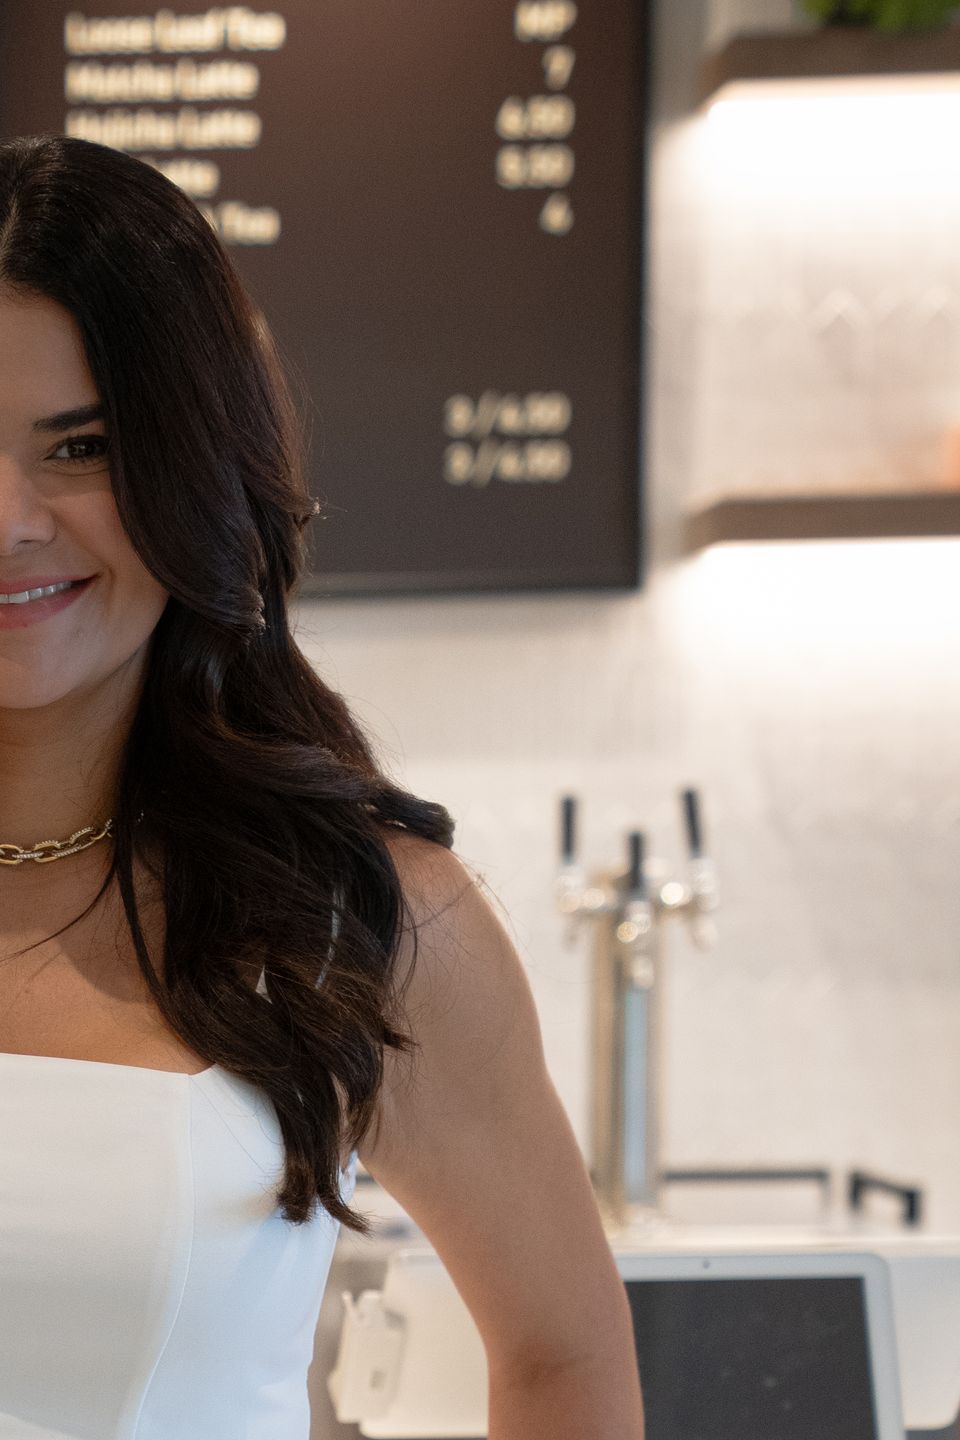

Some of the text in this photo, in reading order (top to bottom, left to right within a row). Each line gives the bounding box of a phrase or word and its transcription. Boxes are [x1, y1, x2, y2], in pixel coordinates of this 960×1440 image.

[224, 8, 285, 49] Tea
[179, 59, 260, 99] Latte
[180, 107, 261, 147] Latte
